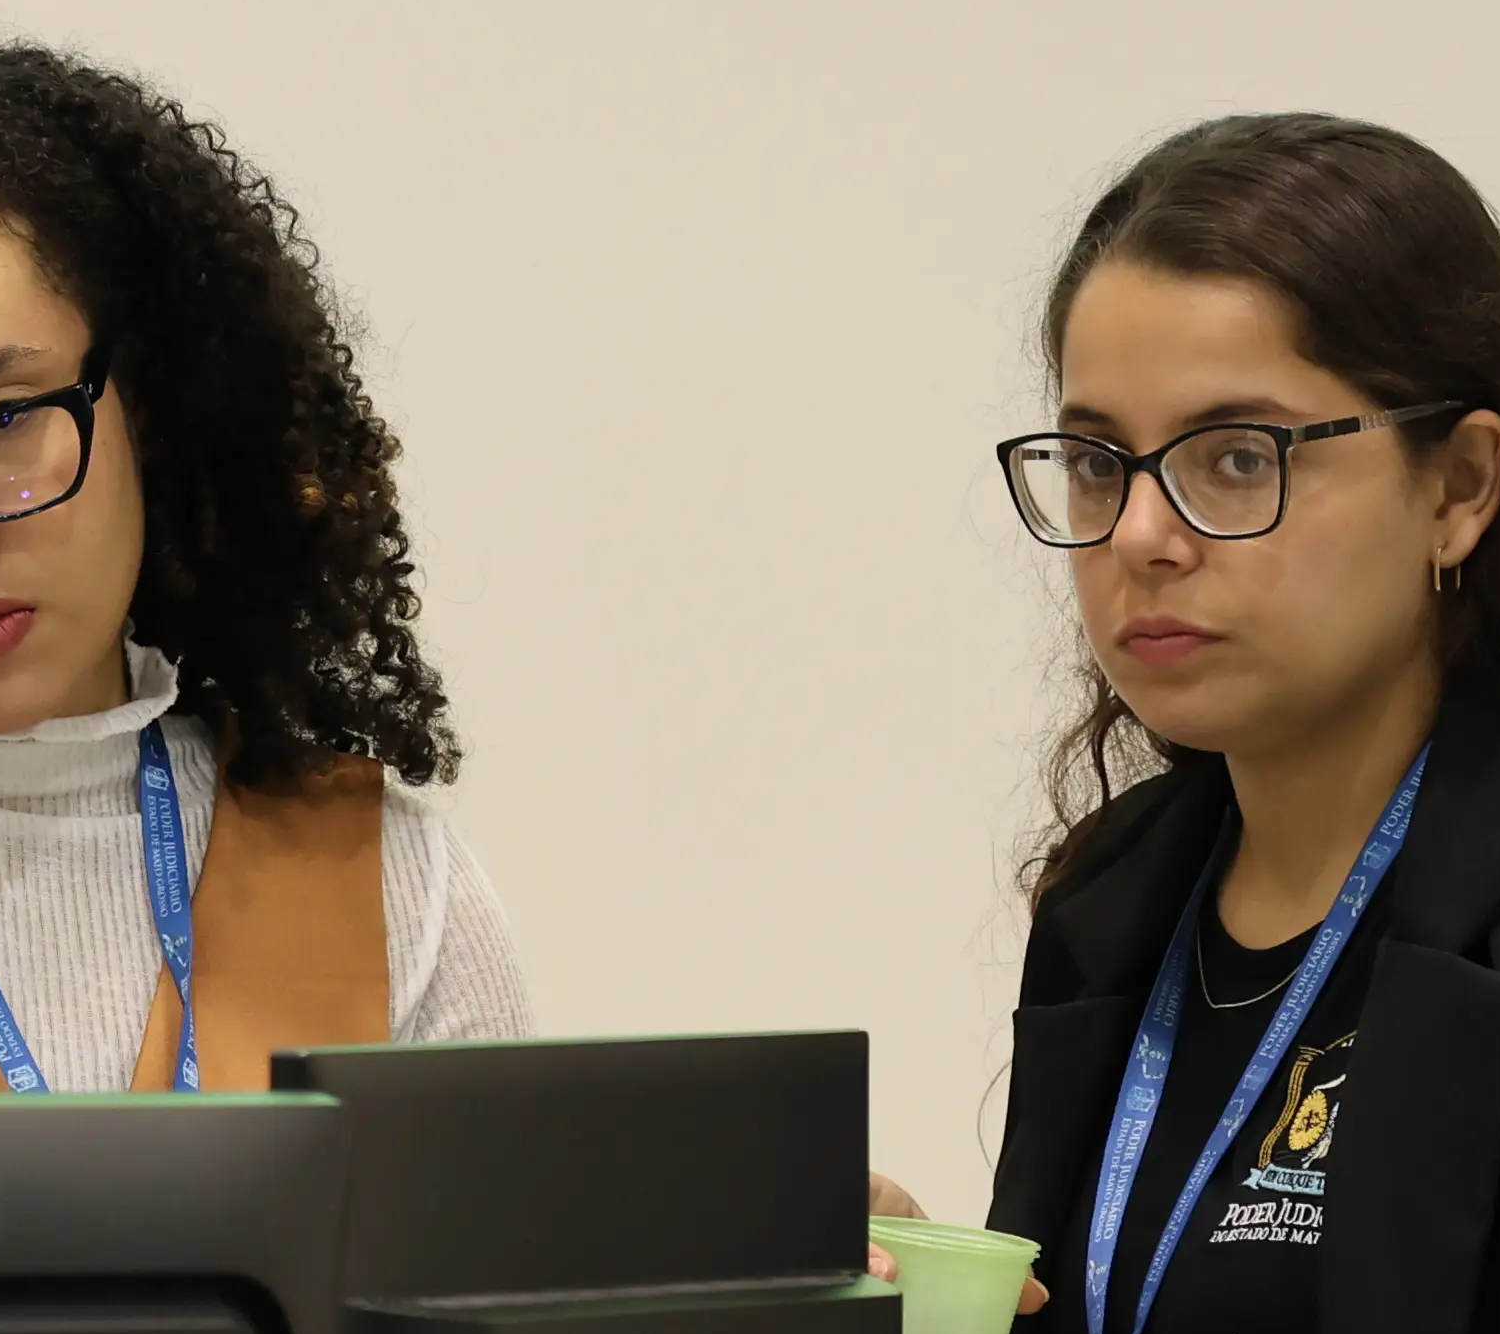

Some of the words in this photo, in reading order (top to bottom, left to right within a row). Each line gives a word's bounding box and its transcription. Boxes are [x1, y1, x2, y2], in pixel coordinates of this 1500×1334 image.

[147, 795, 158, 831] ESTADO
[159, 798, 174, 838] PODER
[1380, 790, 1415, 835] PODER
[150, 833, 160, 845] DE
[152, 849, 163, 877] MATO
[164, 842, 182, 913] JUDICIÁRIO
[155, 878, 168, 917] GROSSO
[1259, 1012, 1290, 1056] PODER
[1287, 929, 1333, 1008] JUDICIÁRIO
[1291, 1007, 1302, 1020] DE
[0, 1020, 24, 1058] ESTADO
[1114, 1117, 1132, 1154] ESTADO
[1124, 1120, 1146, 1160] PODER
[1110, 1156, 1121, 1169] DE
[1103, 1165, 1131, 1240] JUDICIÁRIO
[1104, 1172, 1116, 1201] MATO
[1219, 1202, 1277, 1226] PODER
[1271, 1198, 1323, 1227] JUDI
[1268, 1228, 1288, 1241] DE
